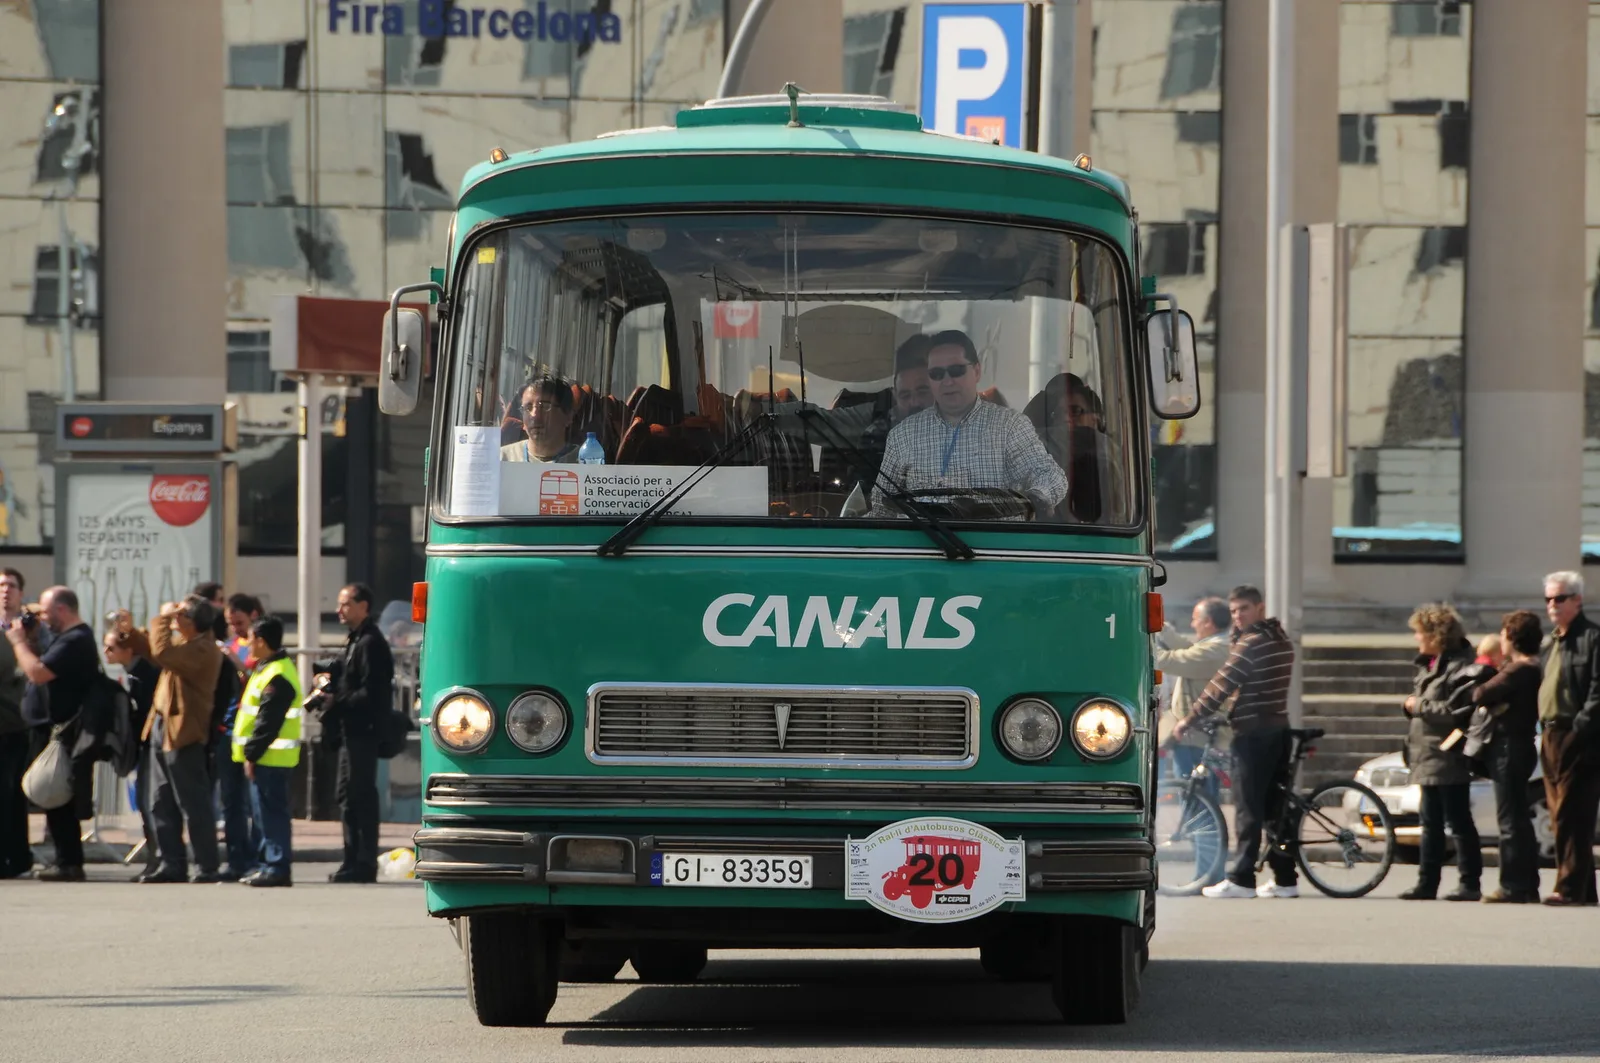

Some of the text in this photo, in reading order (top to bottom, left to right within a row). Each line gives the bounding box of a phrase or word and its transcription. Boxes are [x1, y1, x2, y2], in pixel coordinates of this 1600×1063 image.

[328, 0, 622, 44] Fira Barcelona
[934, 16, 1010, 137] P
[152, 418, 204, 435] Espanya
[583, 474, 641, 485] Associació
[643, 477, 662, 487] per
[584, 486, 594, 496] la
[597, 486, 665, 498] Recuperació
[583, 498, 651, 509] Conservació
[78, 516, 146, 529] 125 ANYS
[77, 532, 160, 546] REPARTINT
[702, 592, 983, 650] CANALS
[1104, 613, 1117, 639] 1
[908, 853, 965, 887] 20
